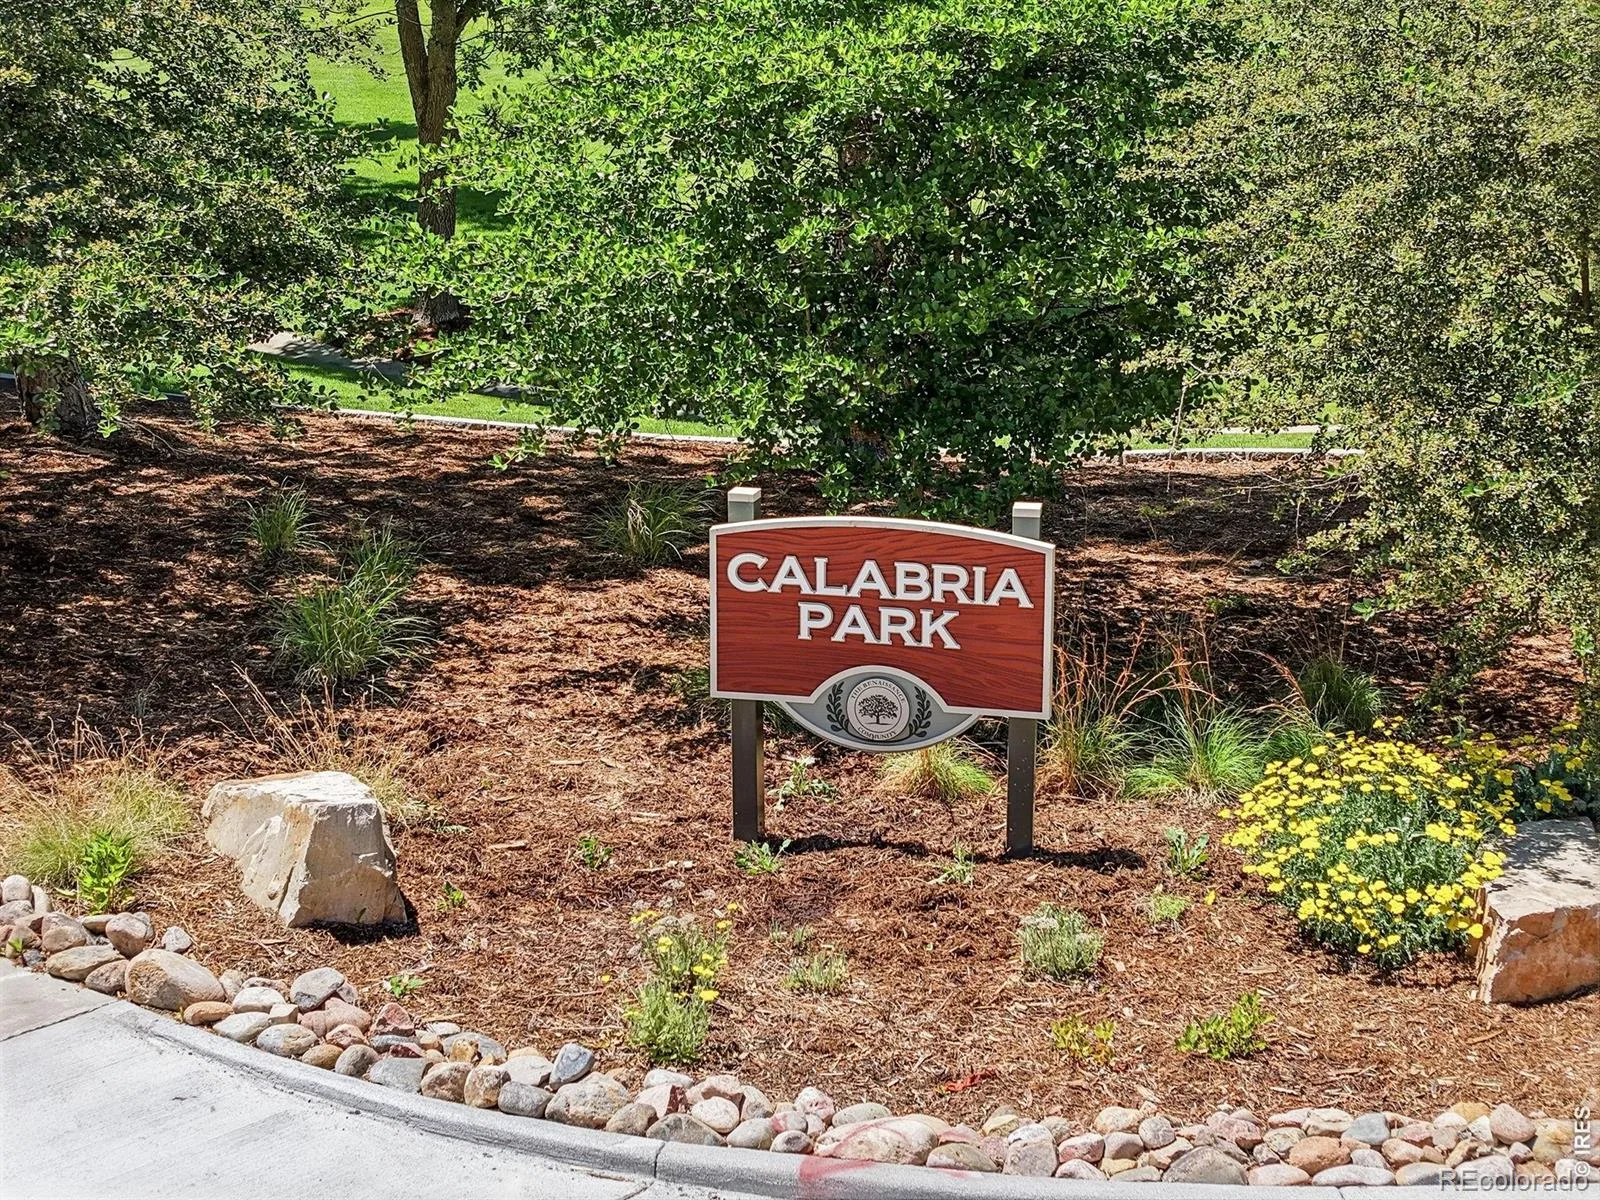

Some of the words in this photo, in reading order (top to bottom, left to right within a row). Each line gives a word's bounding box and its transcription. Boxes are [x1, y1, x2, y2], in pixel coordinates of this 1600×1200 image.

[727, 552, 1035, 608] CALABRIA
[797, 601, 961, 649] PARK
[851, 685, 864, 699] THE
[862, 680, 906, 704] RENAISSANCE
[857, 726, 898, 740] COMMUNITY
